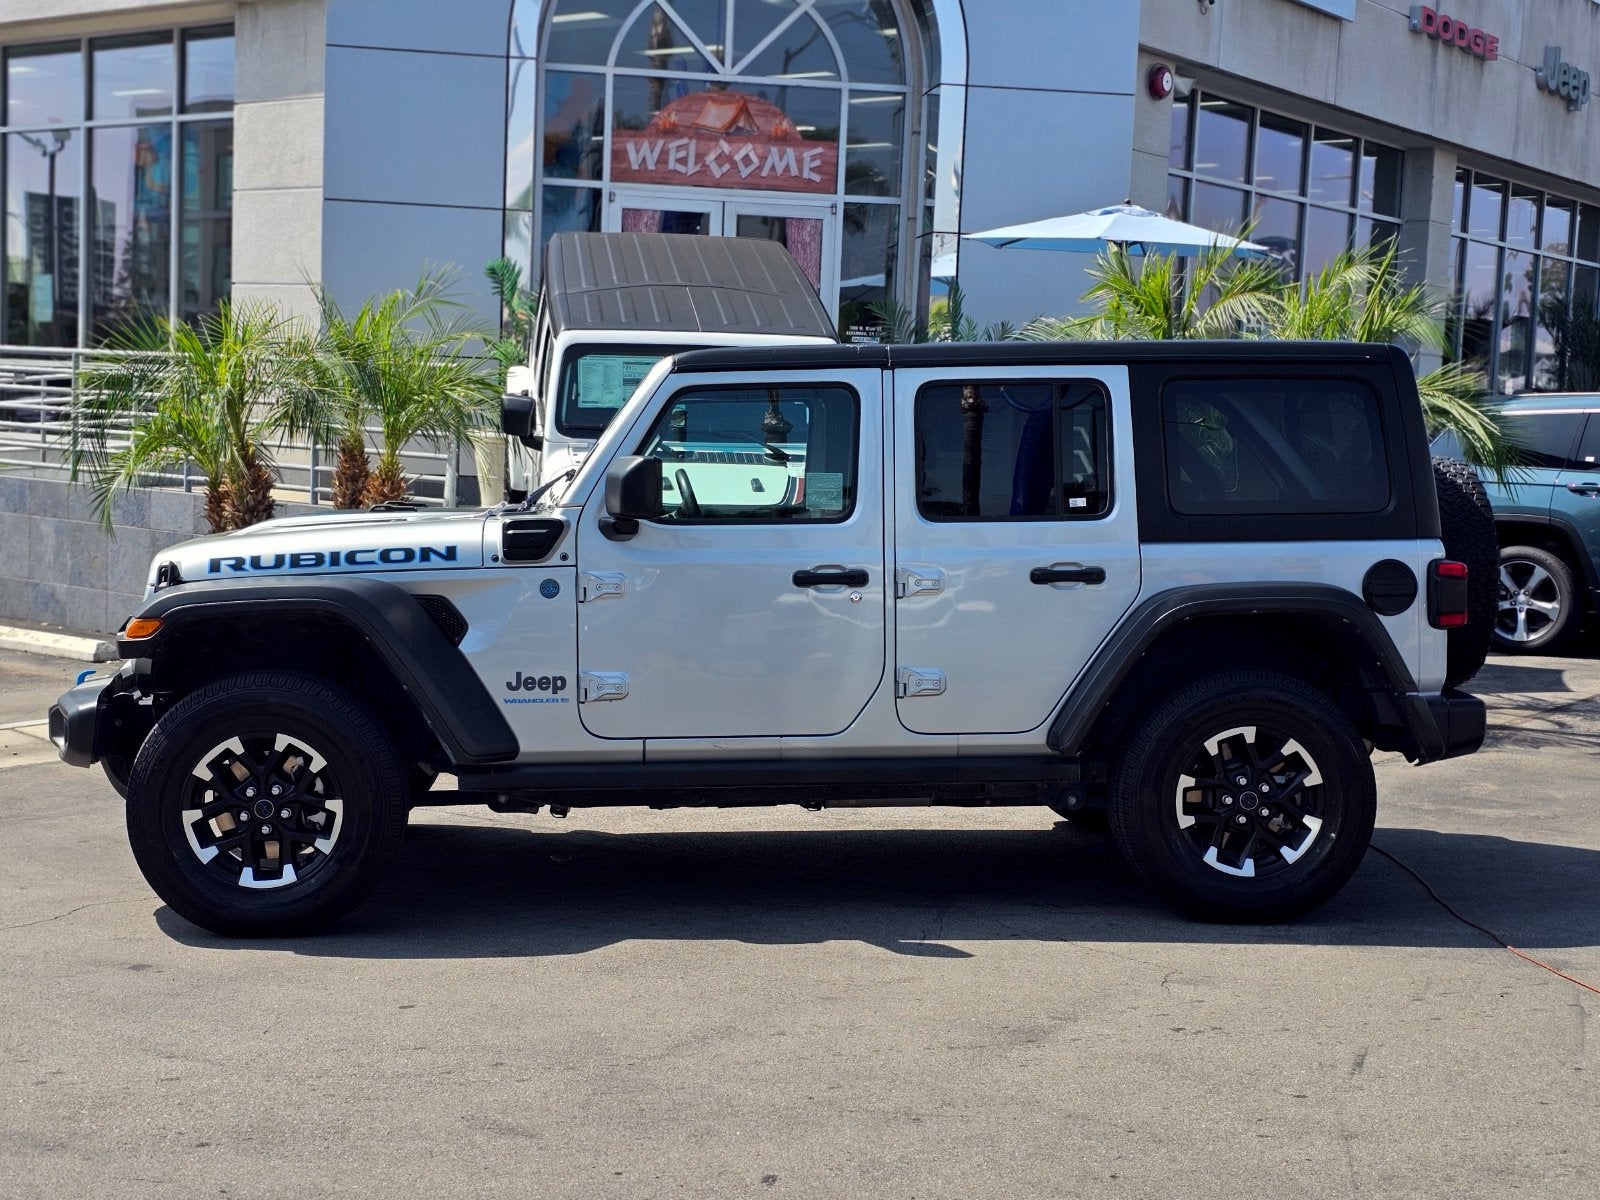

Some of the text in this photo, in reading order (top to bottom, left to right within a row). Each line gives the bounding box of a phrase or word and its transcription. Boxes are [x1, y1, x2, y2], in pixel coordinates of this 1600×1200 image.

[1417, 5, 1500, 61] DODGE
[1536, 46, 1590, 111] Jeep
[626, 137, 825, 184] WELCOME
[207, 545, 459, 574] RUBICON
[506, 671, 567, 695] Jeep
